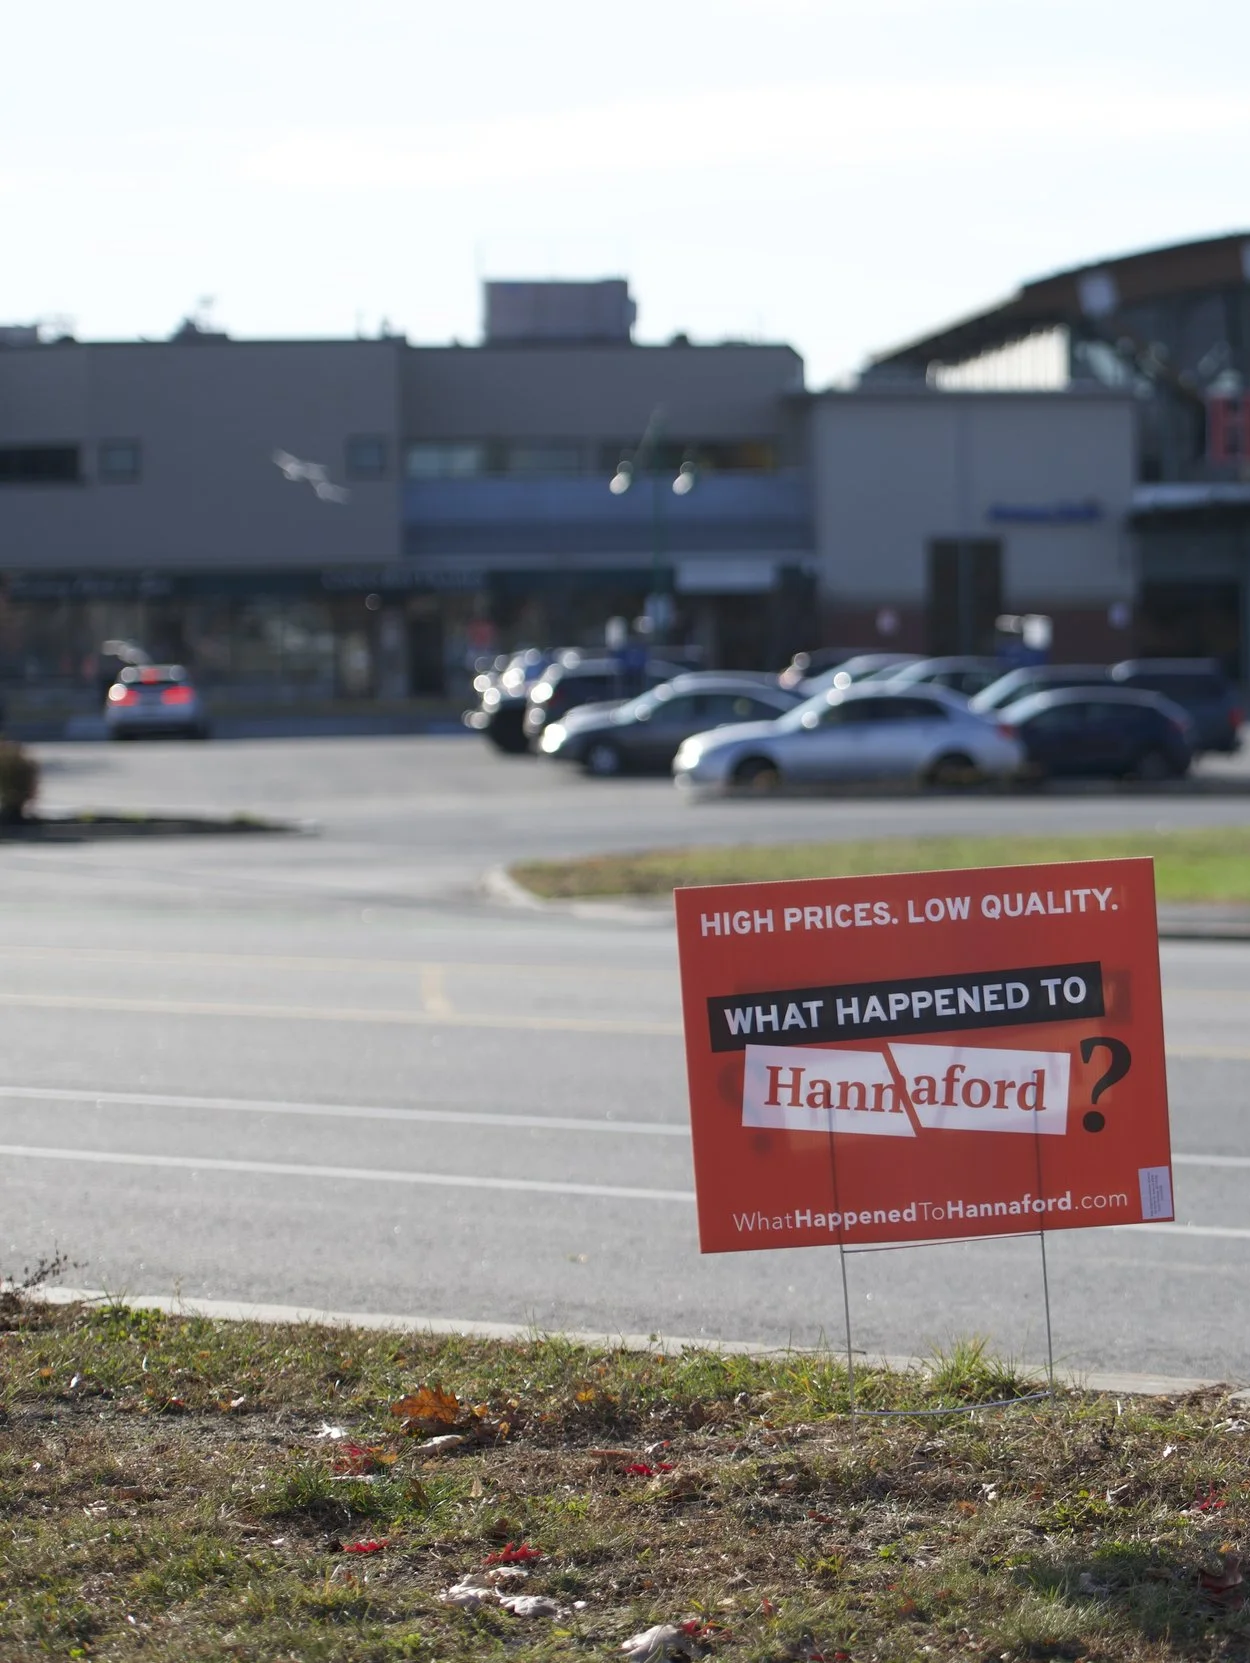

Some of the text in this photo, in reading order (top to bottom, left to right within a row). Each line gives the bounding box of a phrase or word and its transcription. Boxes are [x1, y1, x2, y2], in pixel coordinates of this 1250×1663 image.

[701, 887, 1119, 936] HIGH PRICES. LOW QUALITY.
[724, 977, 1087, 1035] WHAT HAPPENED TO
[764, 1065, 1047, 1113] Hannaford
[733, 1191, 1128, 1232] WhatHappenedToHannaford.com
